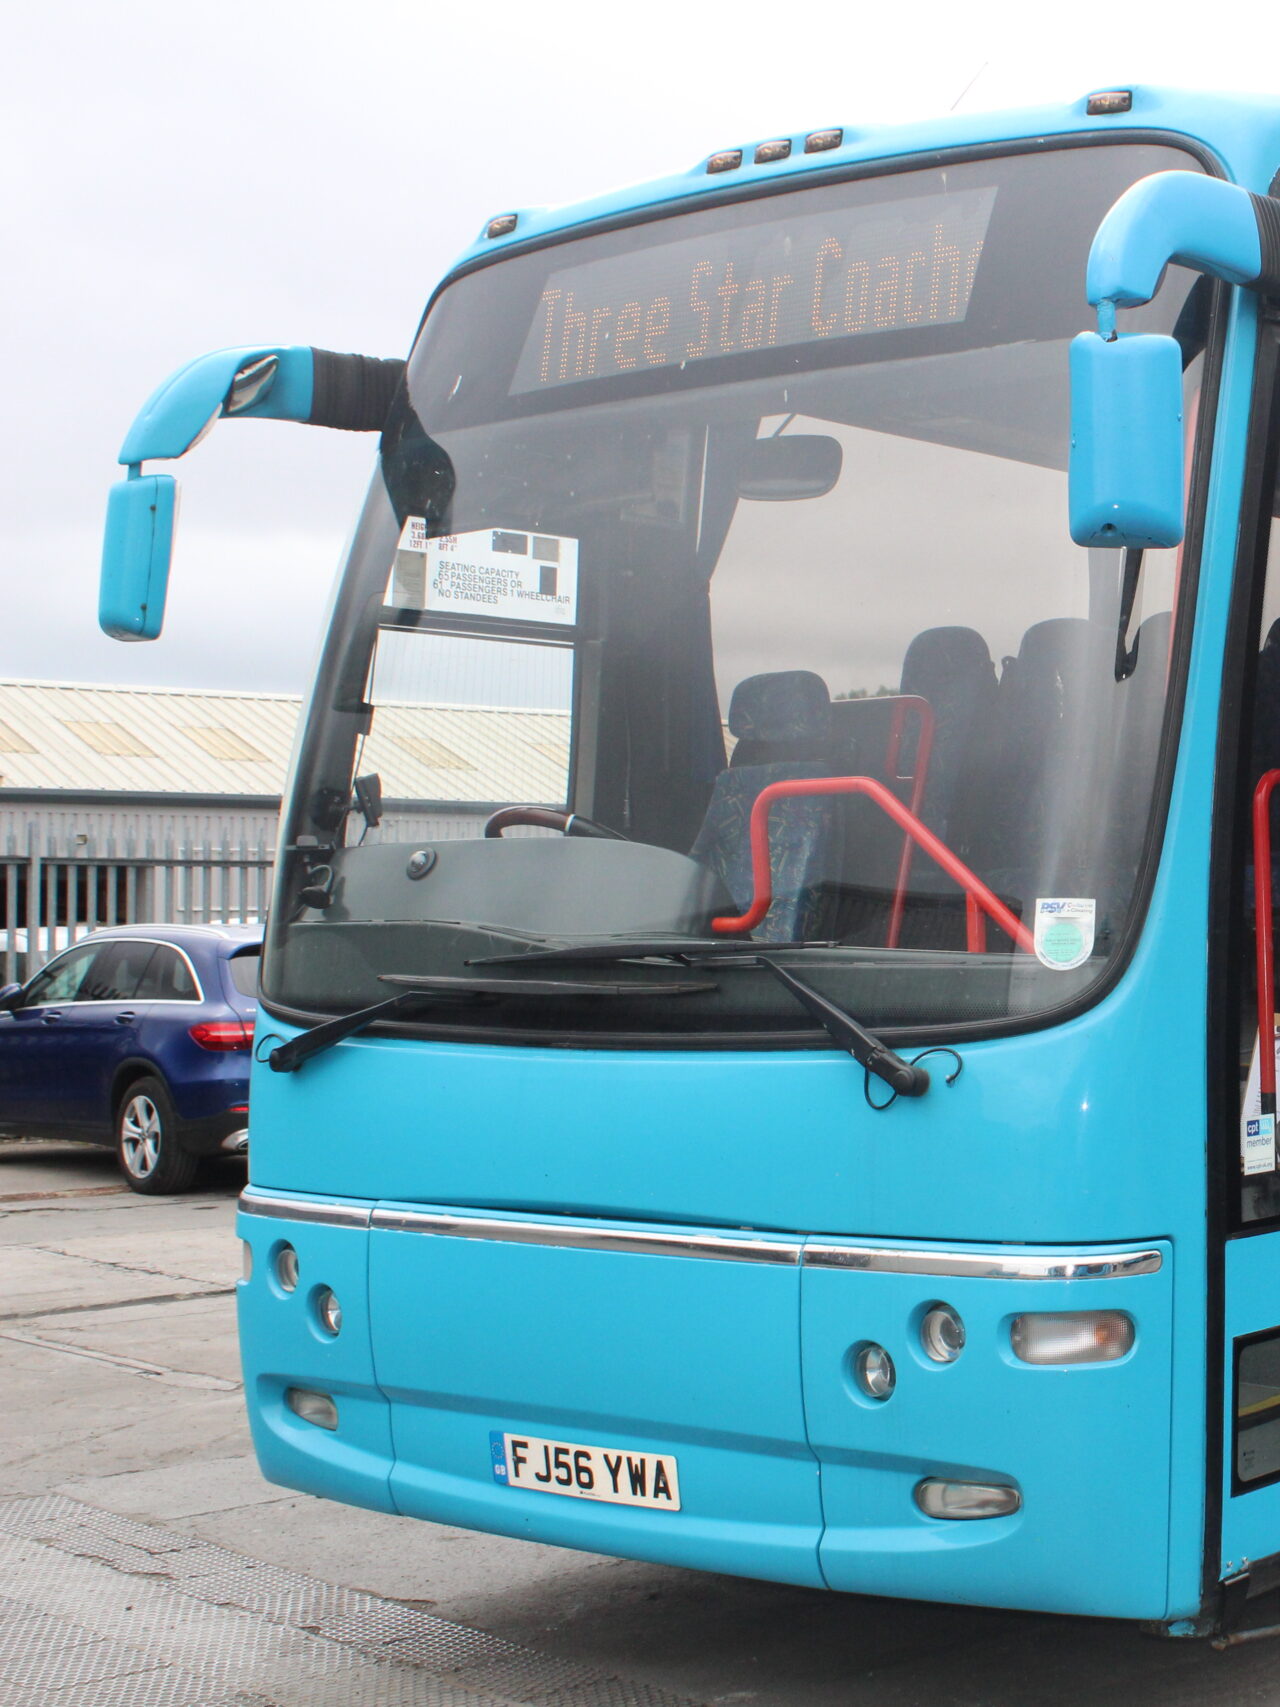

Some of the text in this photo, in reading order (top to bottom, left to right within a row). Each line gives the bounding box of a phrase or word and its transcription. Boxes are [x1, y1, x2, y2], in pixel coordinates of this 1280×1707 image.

[540, 288, 670, 382] Three
[687, 260, 795, 358] Star
[439, 560, 520, 579] SEATING CAPACITY
[438, 570, 522, 589] 65 PASSENGERS OR
[432, 580, 443, 590] 61
[450, 581, 508, 597] PASSENGERS
[517, 590, 570, 605] WHEELCHAIR
[438, 589, 499, 605] NO STANDEES
[1247, 1121, 1259, 1134] cpt
[1247, 1136, 1272, 1148] member
[494, 1464, 506, 1476] GB
[511, 1440, 672, 1501] FJ56 YWA
